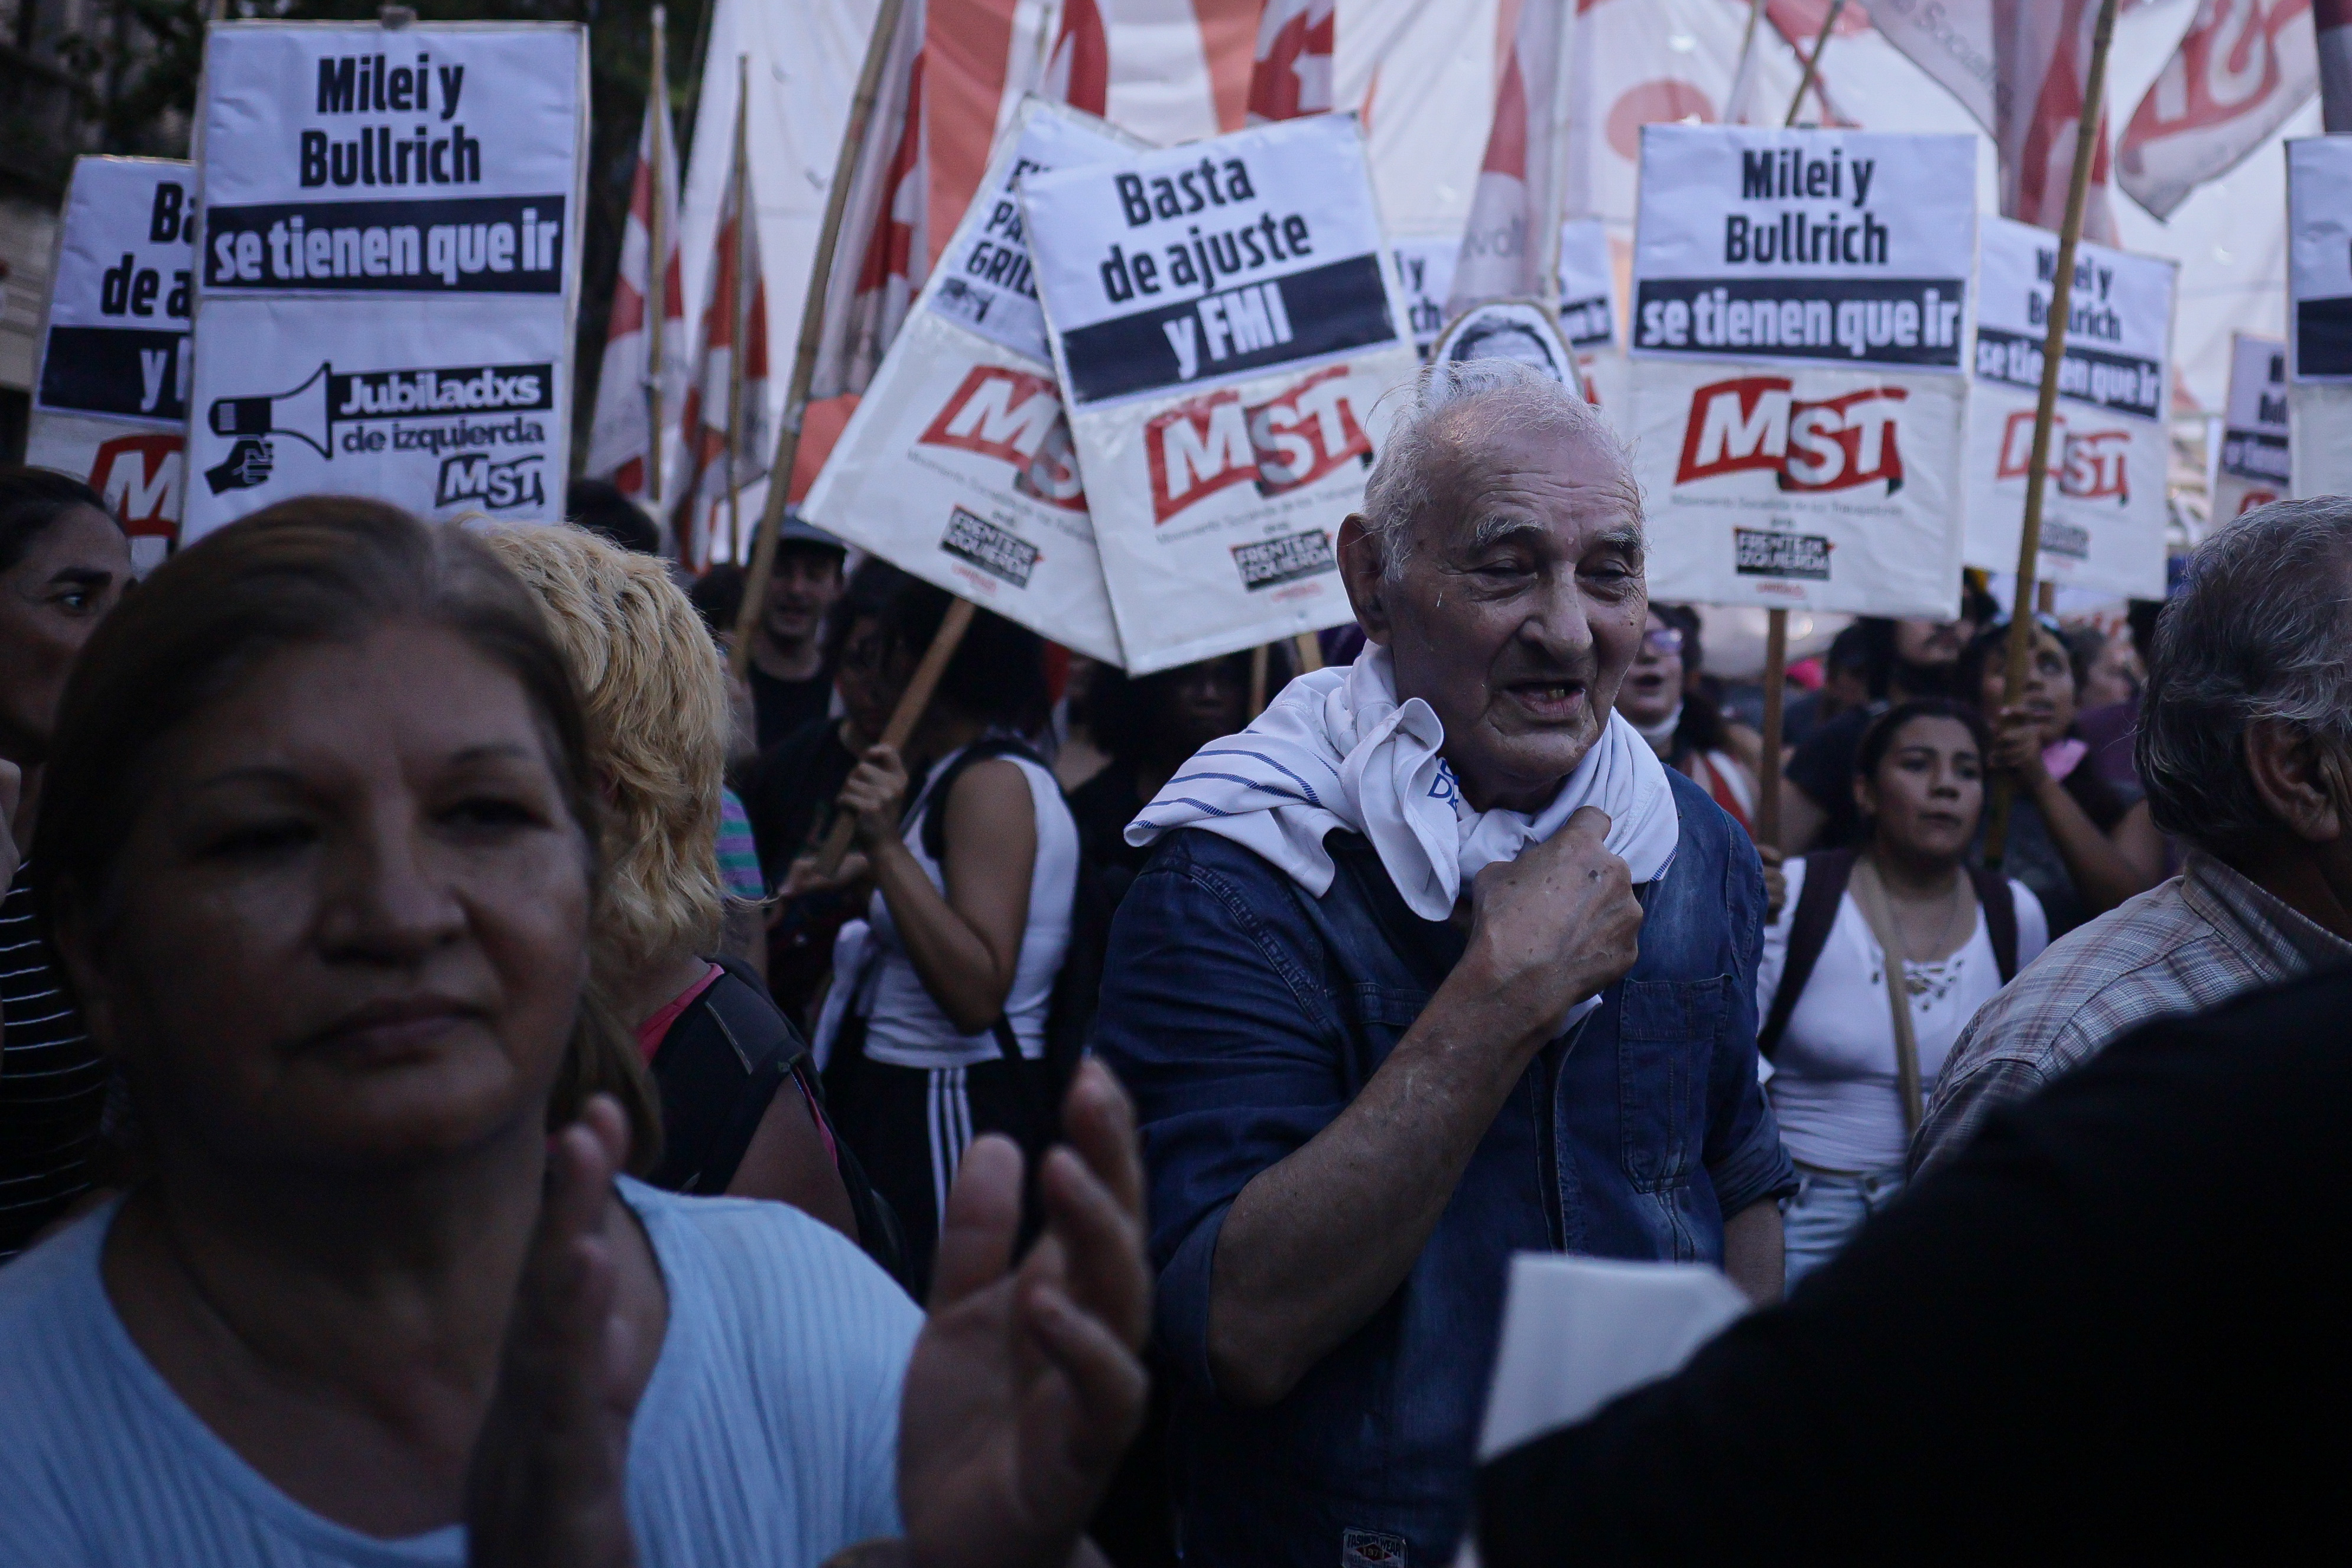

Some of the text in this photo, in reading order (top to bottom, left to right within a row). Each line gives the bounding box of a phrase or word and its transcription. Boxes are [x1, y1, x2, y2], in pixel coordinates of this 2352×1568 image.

[317, 52, 464, 121] Milei y
[300, 123, 481, 188] Bullrich
[1742, 148, 1876, 208] Milei y
[1114, 156, 1256, 228] Basta
[214, 207, 559, 286] se tienen que ir
[966, 240, 1040, 300] GRIL
[1100, 241, 1162, 304] de
[1168, 212, 1315, 292] ajuste
[1725, 212, 1889, 264] Bullrich
[100, 253, 160, 318] de
[1162, 279, 1293, 382] y FMI
[1642, 298, 1690, 346] se
[1692, 287, 1832, 347] tienen
[1836, 298, 1921, 357] que
[1922, 288, 1960, 347] ir
[140, 347, 167, 414] y
[340, 370, 542, 415] Jubiladxs
[342, 416, 545, 454] de izquierda
[1157, 372, 1359, 502] MST
[1691, 387, 1908, 488] MST
[440, 454, 545, 509] MST
